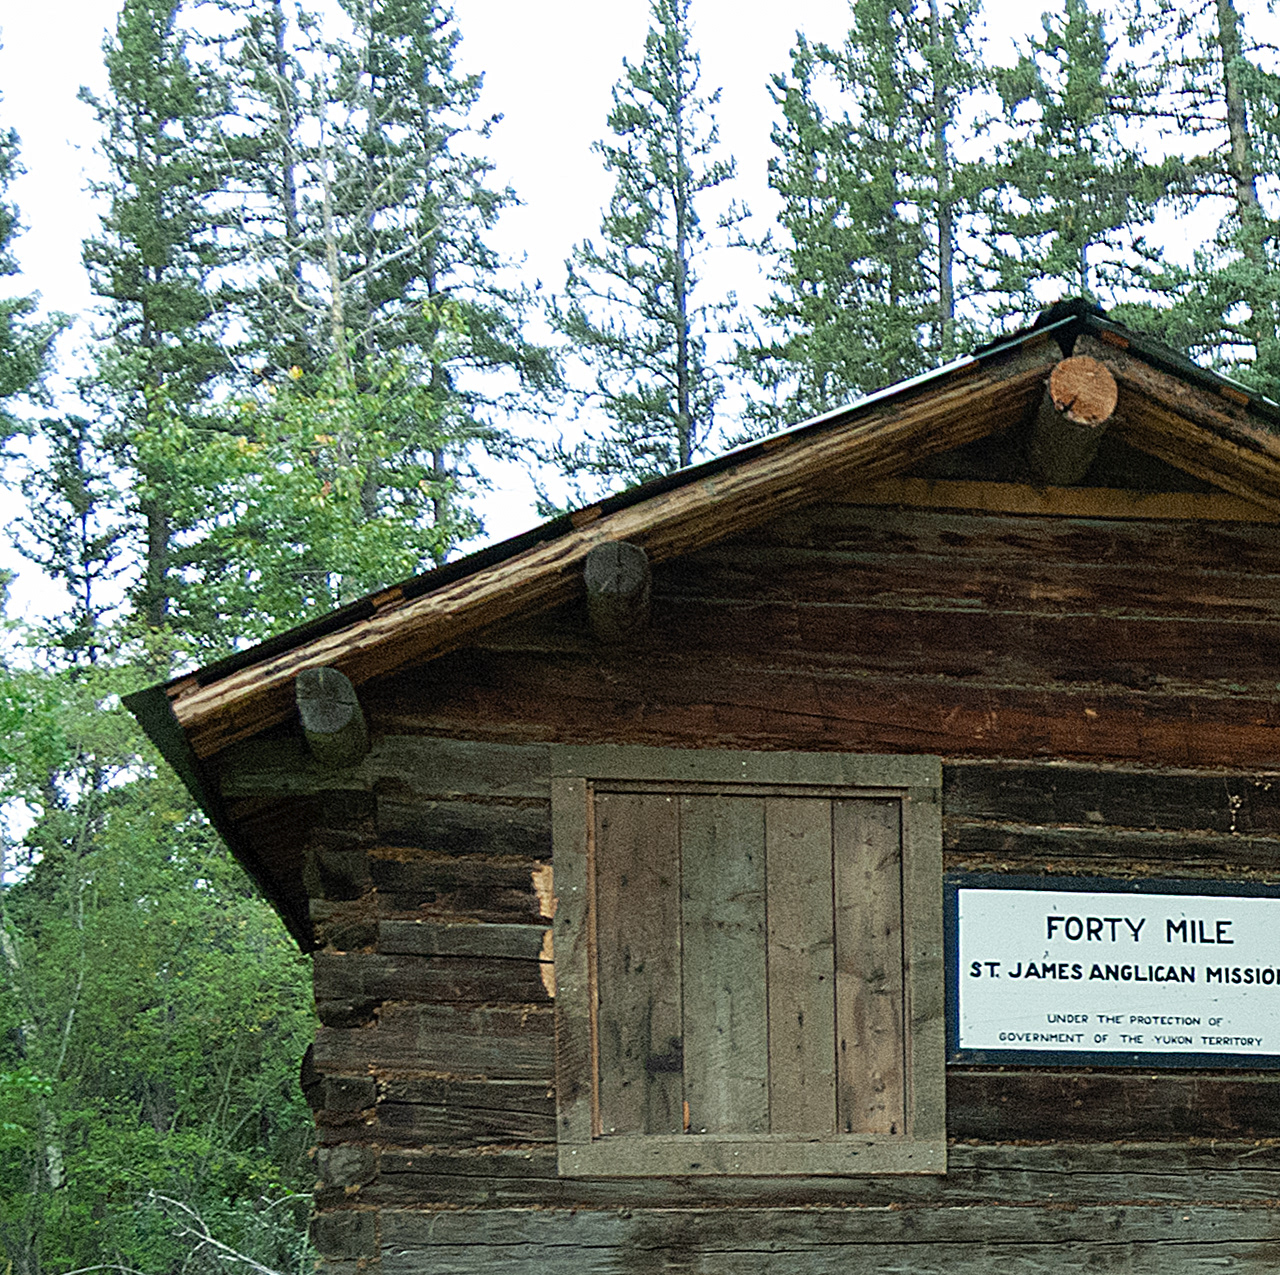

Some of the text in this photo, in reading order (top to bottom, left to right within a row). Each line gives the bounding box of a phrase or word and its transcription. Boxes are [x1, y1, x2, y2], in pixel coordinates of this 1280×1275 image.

[1046, 915, 1235, 945] FORTY MILE
[969, 961, 1001, 978] ST.
[1008, 962, 1083, 980] JAMES
[1088, 963, 1195, 983] ANGLICAN
[1047, 1014, 1223, 1026] UNDER THE PROTECTION OF
[998, 1032, 1263, 1046] GOVERNMENT OF THE YUKON TERRITORY
